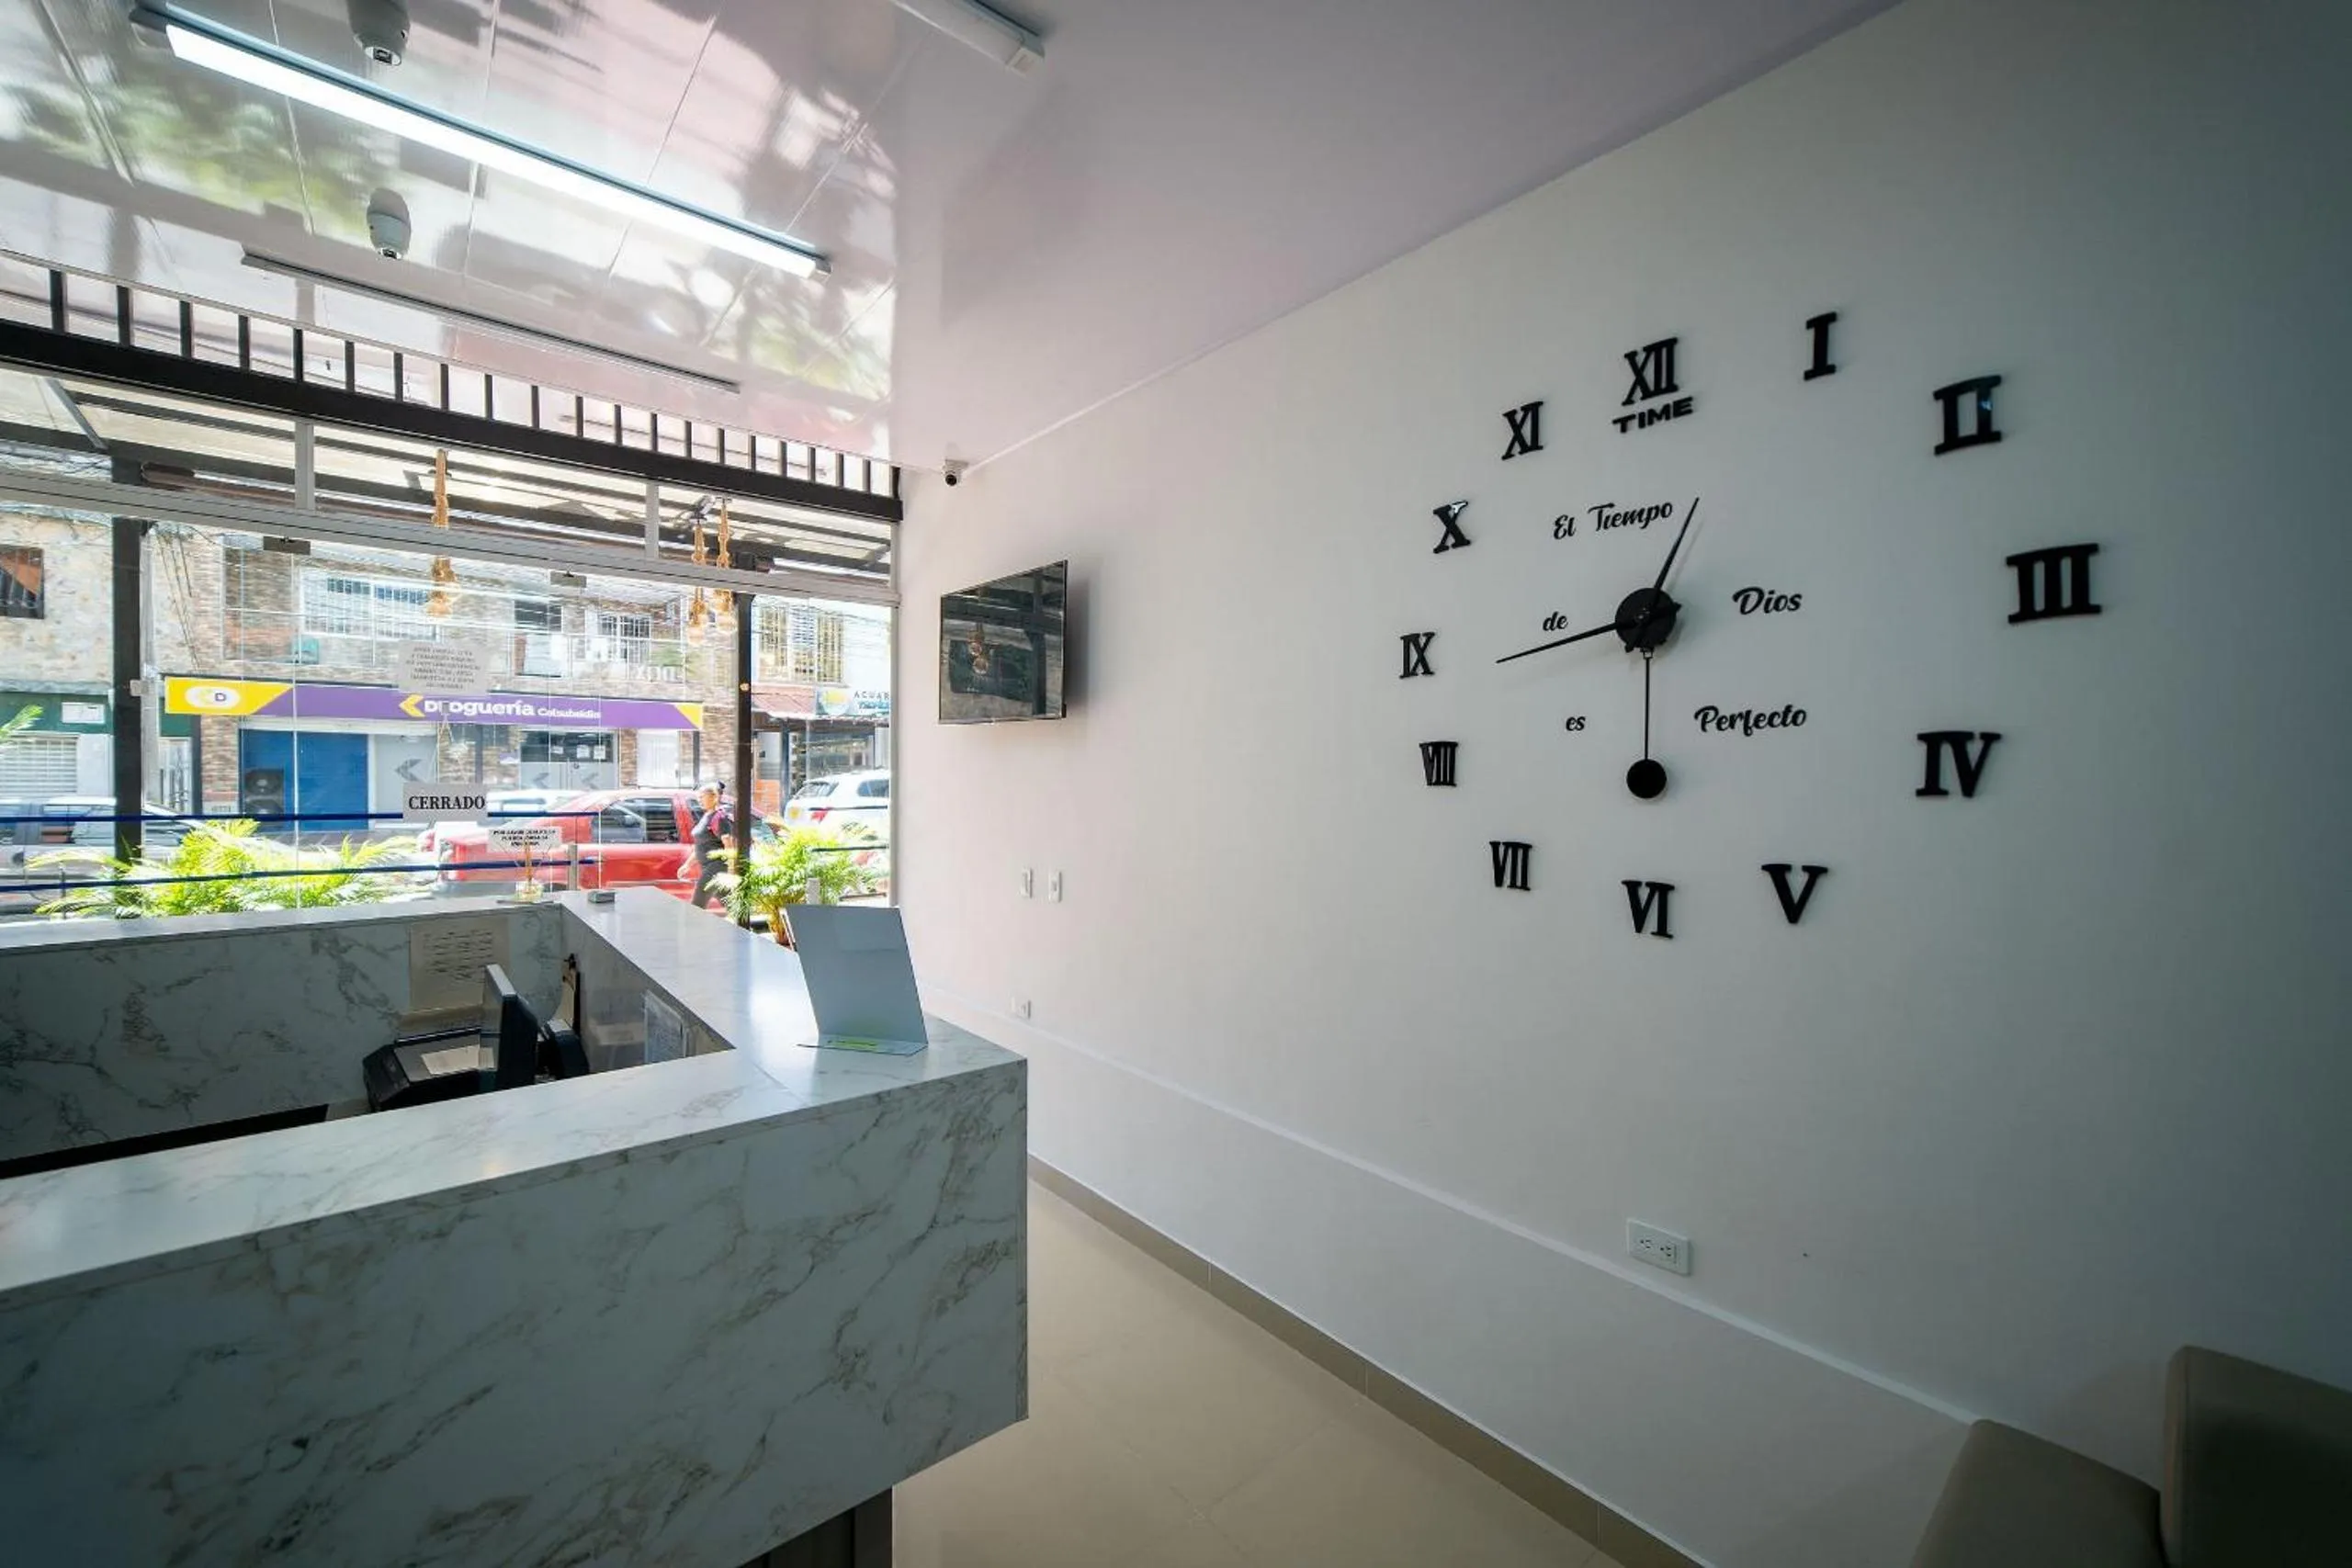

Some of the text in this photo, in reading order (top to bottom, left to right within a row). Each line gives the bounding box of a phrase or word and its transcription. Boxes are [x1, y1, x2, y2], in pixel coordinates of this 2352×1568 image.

[1622, 337, 1679, 405] XII
[1804, 311, 1838, 381] I
[1501, 401, 1544, 460] XI
[1612, 397, 1693, 434] TIME
[1933, 375, 2003, 456] II
[1433, 501, 1471, 554] X
[1554, 501, 1672, 539] El Tiempo
[1543, 586, 1802, 631] de Dios
[2006, 543, 2103, 625] III
[1399, 632, 1435, 679] IX
[1566, 705, 1806, 738] es Perfecto
[1419, 741, 1459, 787] VIII
[1916, 730, 2002, 798] IV
[408, 795, 485, 809] CERRADO
[1489, 841, 1532, 891] VII
[1622, 880, 1675, 940] VI
[1761, 863, 1828, 925] V
